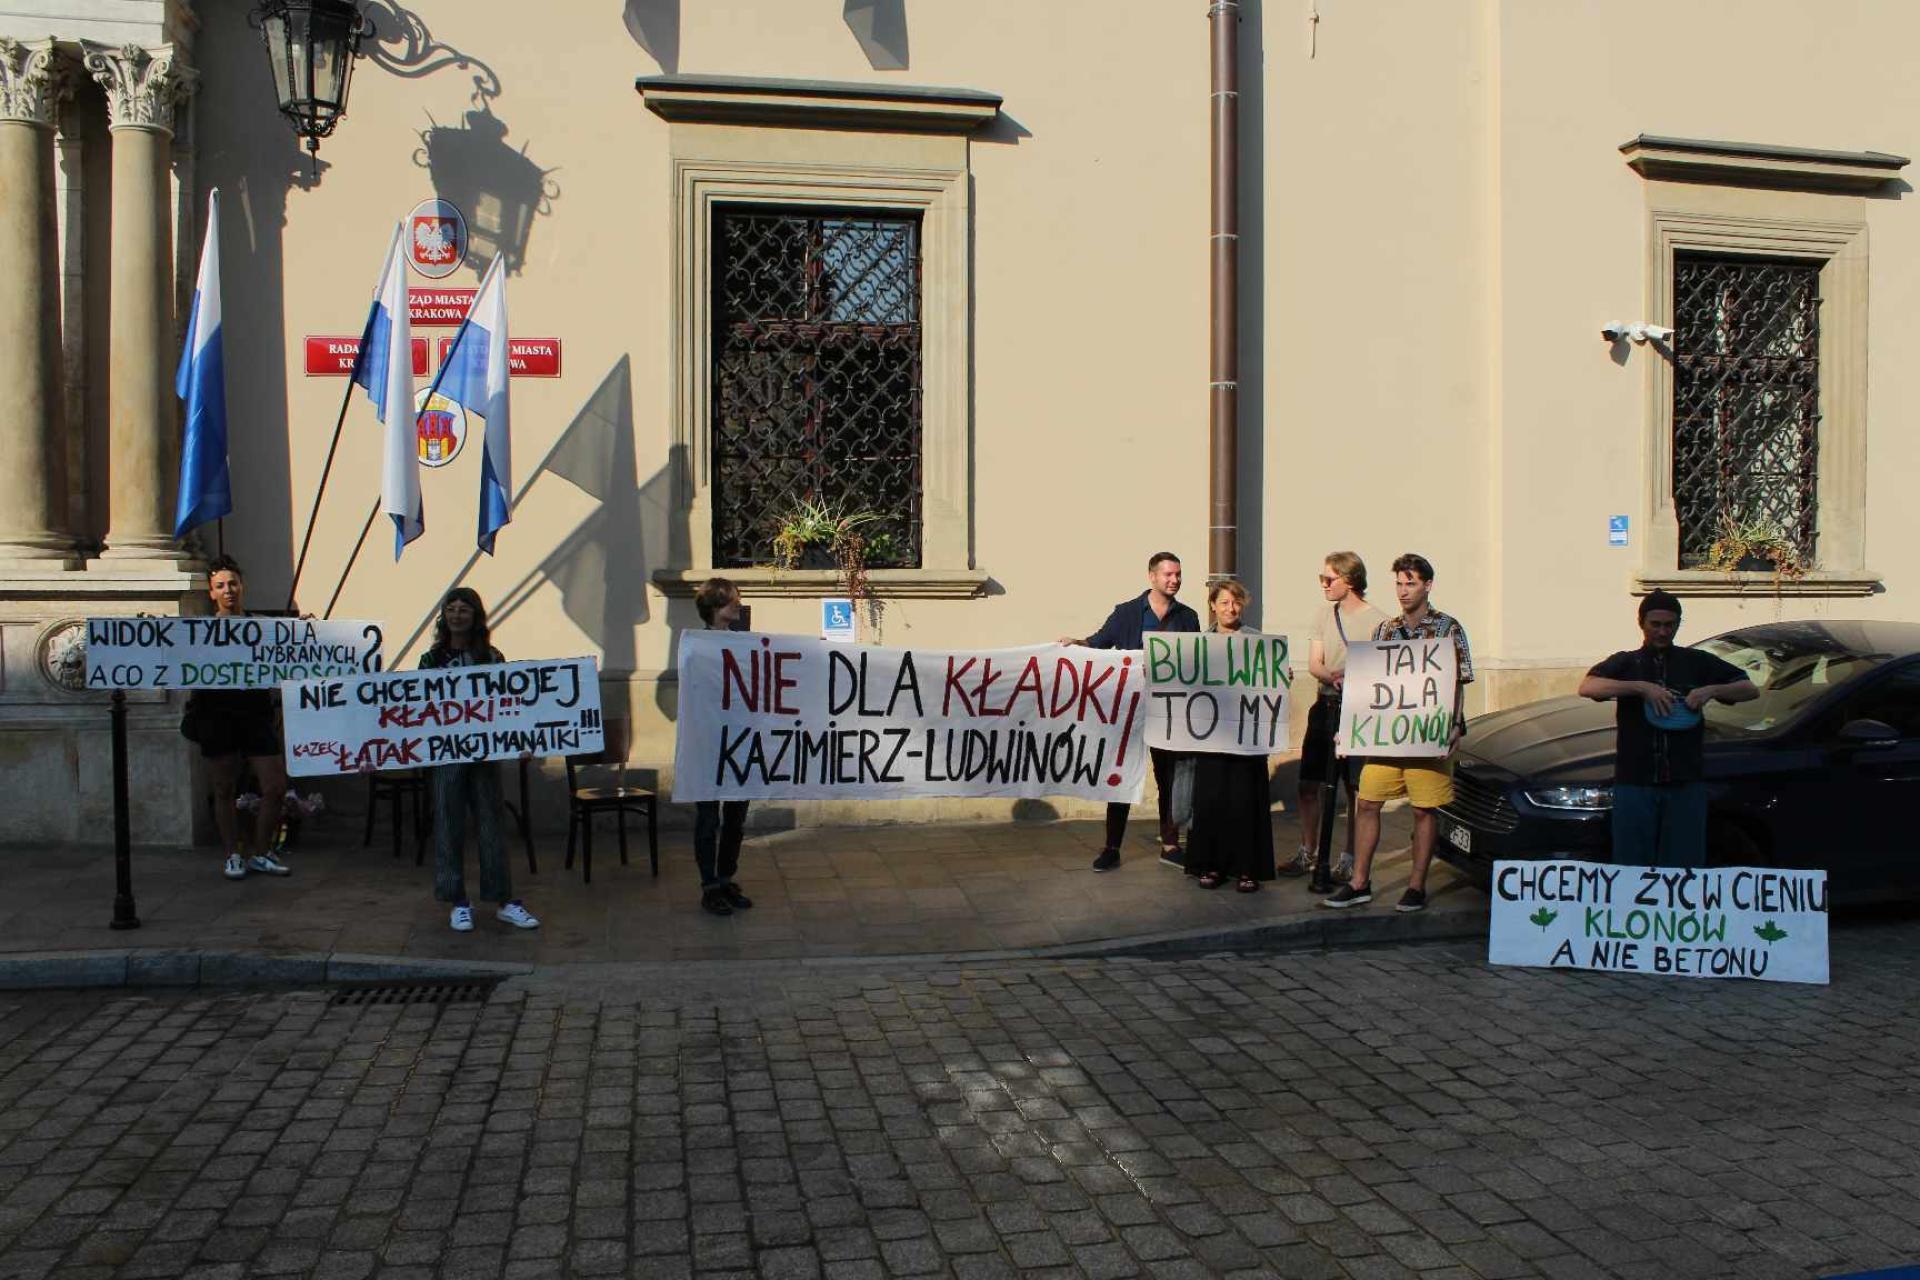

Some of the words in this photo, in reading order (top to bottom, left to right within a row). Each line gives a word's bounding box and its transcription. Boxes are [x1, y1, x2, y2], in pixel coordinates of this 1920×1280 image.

[408, 308, 462, 319] KRAKOWA
[409, 295, 432, 307] ZĄD
[435, 295, 475, 305] MIASTA
[329, 344, 359, 354] RADA
[511, 345, 553, 356] MIASTA
[89, 620, 173, 647] WIDOK
[182, 619, 262, 647] TYLKO
[275, 621, 317, 645] DLA
[153, 665, 169, 686] Z
[1149, 634, 1291, 689] BULWAR
[1376, 643, 1442, 676] TAK
[357, 671, 461, 705] CHCEMY
[466, 664, 580, 708] TWOJEJ
[828, 650, 924, 718] DLA
[1370, 677, 1438, 711] DLA
[1152, 690, 1219, 740] TO
[1238, 694, 1283, 748] MY
[292, 740, 340, 758] KAZEK
[1498, 864, 1621, 904] CHCEMY
[1731, 871, 1829, 913] CIENIU
[1585, 906, 1726, 943] KLONÓW
[1550, 938, 1576, 966] A
[1591, 941, 1639, 970] NIE
[1654, 947, 1769, 977] BETONU
